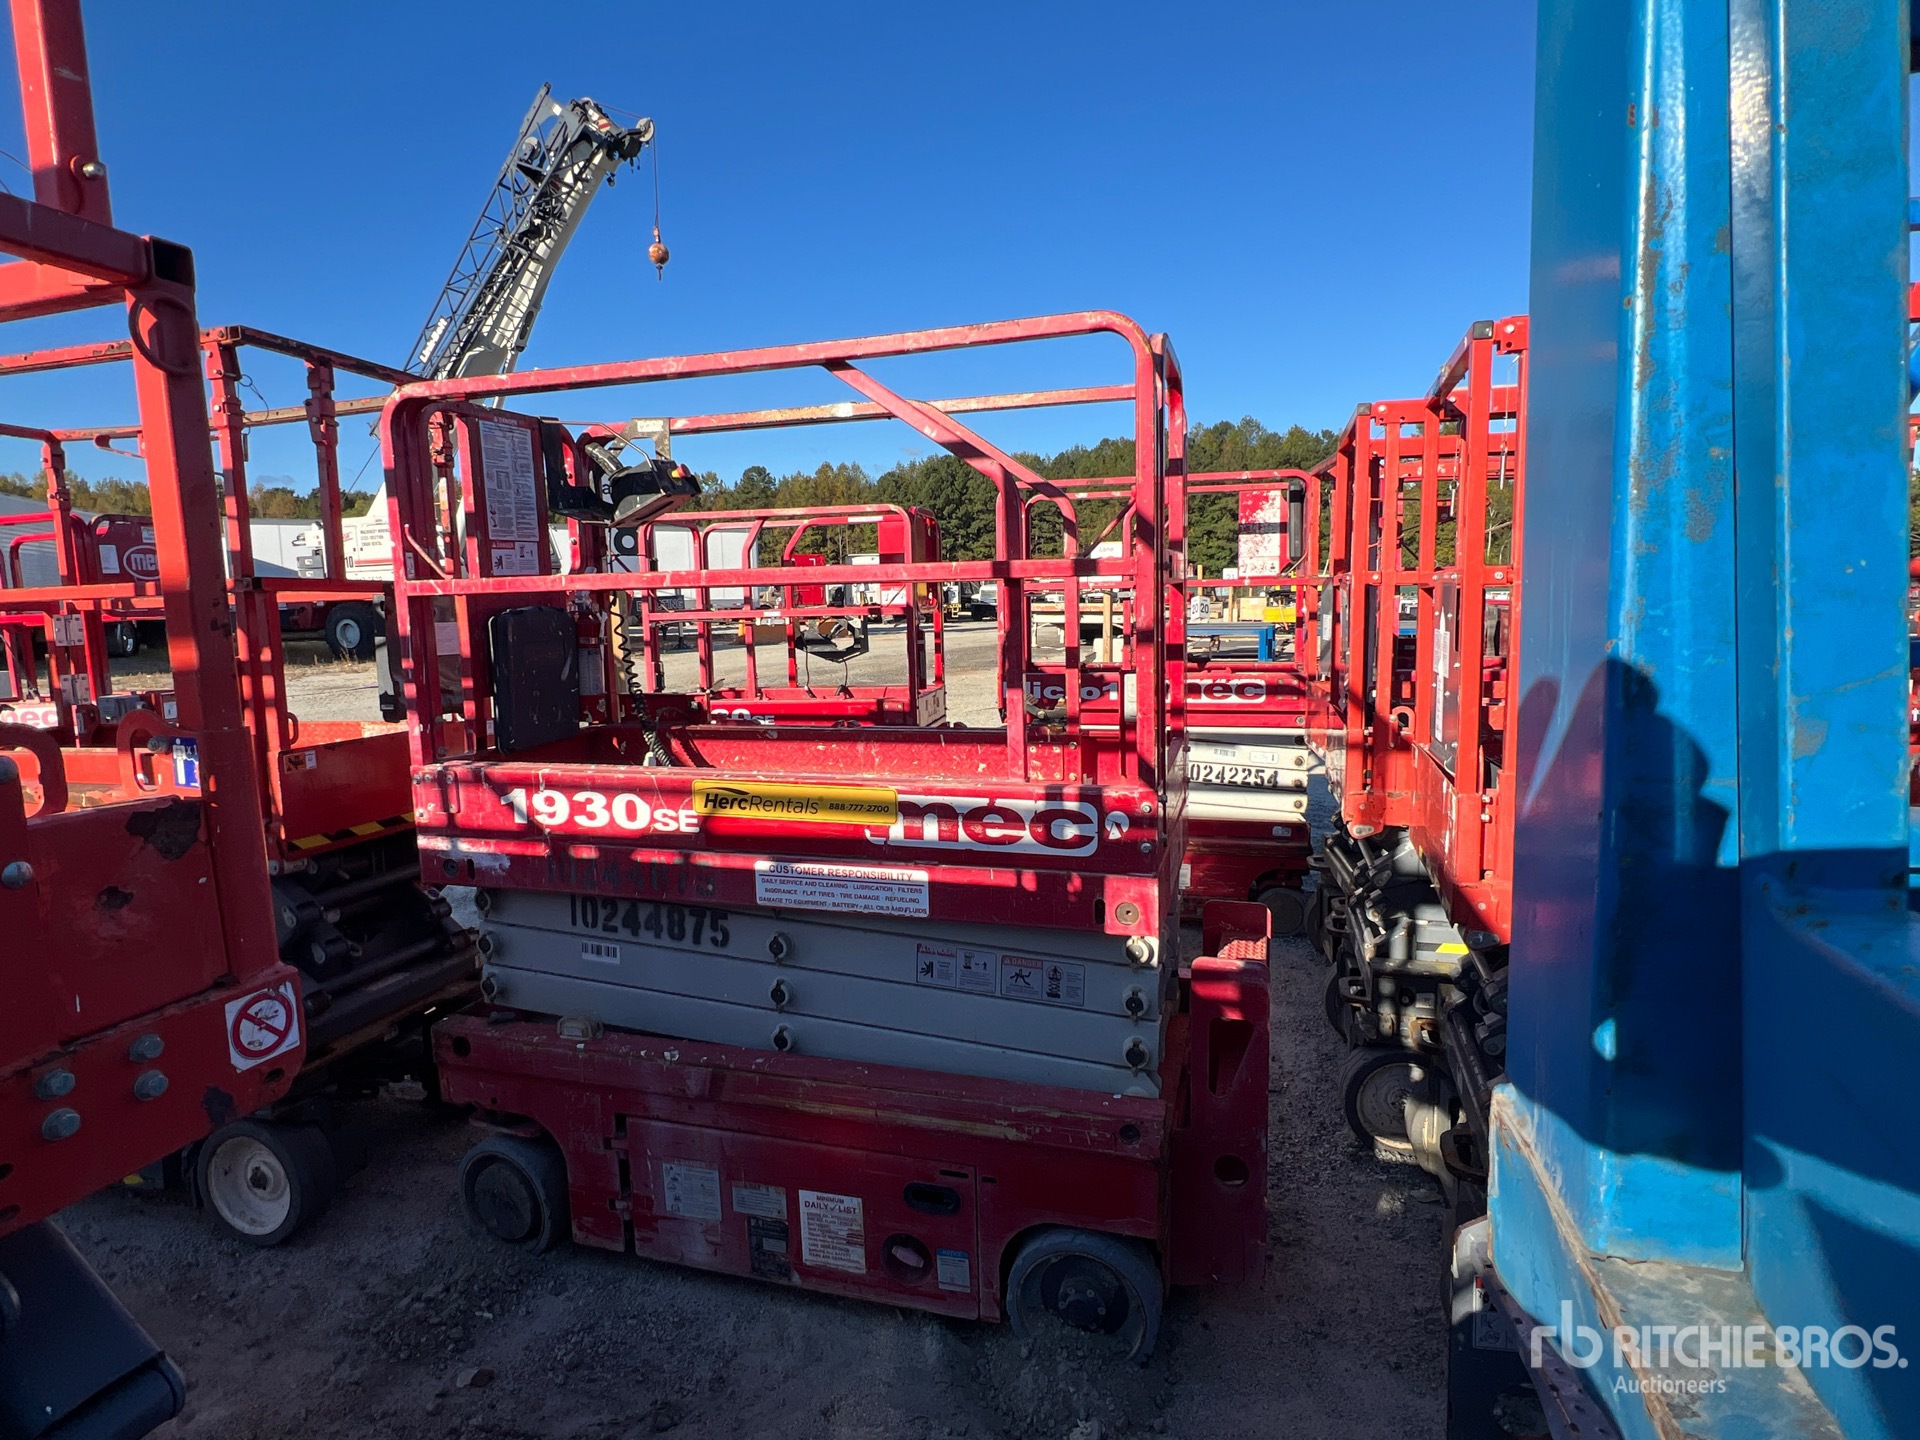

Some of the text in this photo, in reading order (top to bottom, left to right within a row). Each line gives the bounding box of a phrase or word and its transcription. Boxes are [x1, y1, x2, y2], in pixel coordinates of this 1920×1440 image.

[130, 553, 157, 571] me
[1200, 603, 1210, 614] 20
[703, 793, 819, 815] HercRentals
[768, 864, 913, 882] CUSTOMER RESPONSIBILITY
[818, 881, 848, 889] CLEANING
[885, 896, 920, 904] REFUELING
[804, 1200, 858, 1214] DAILY LIST
